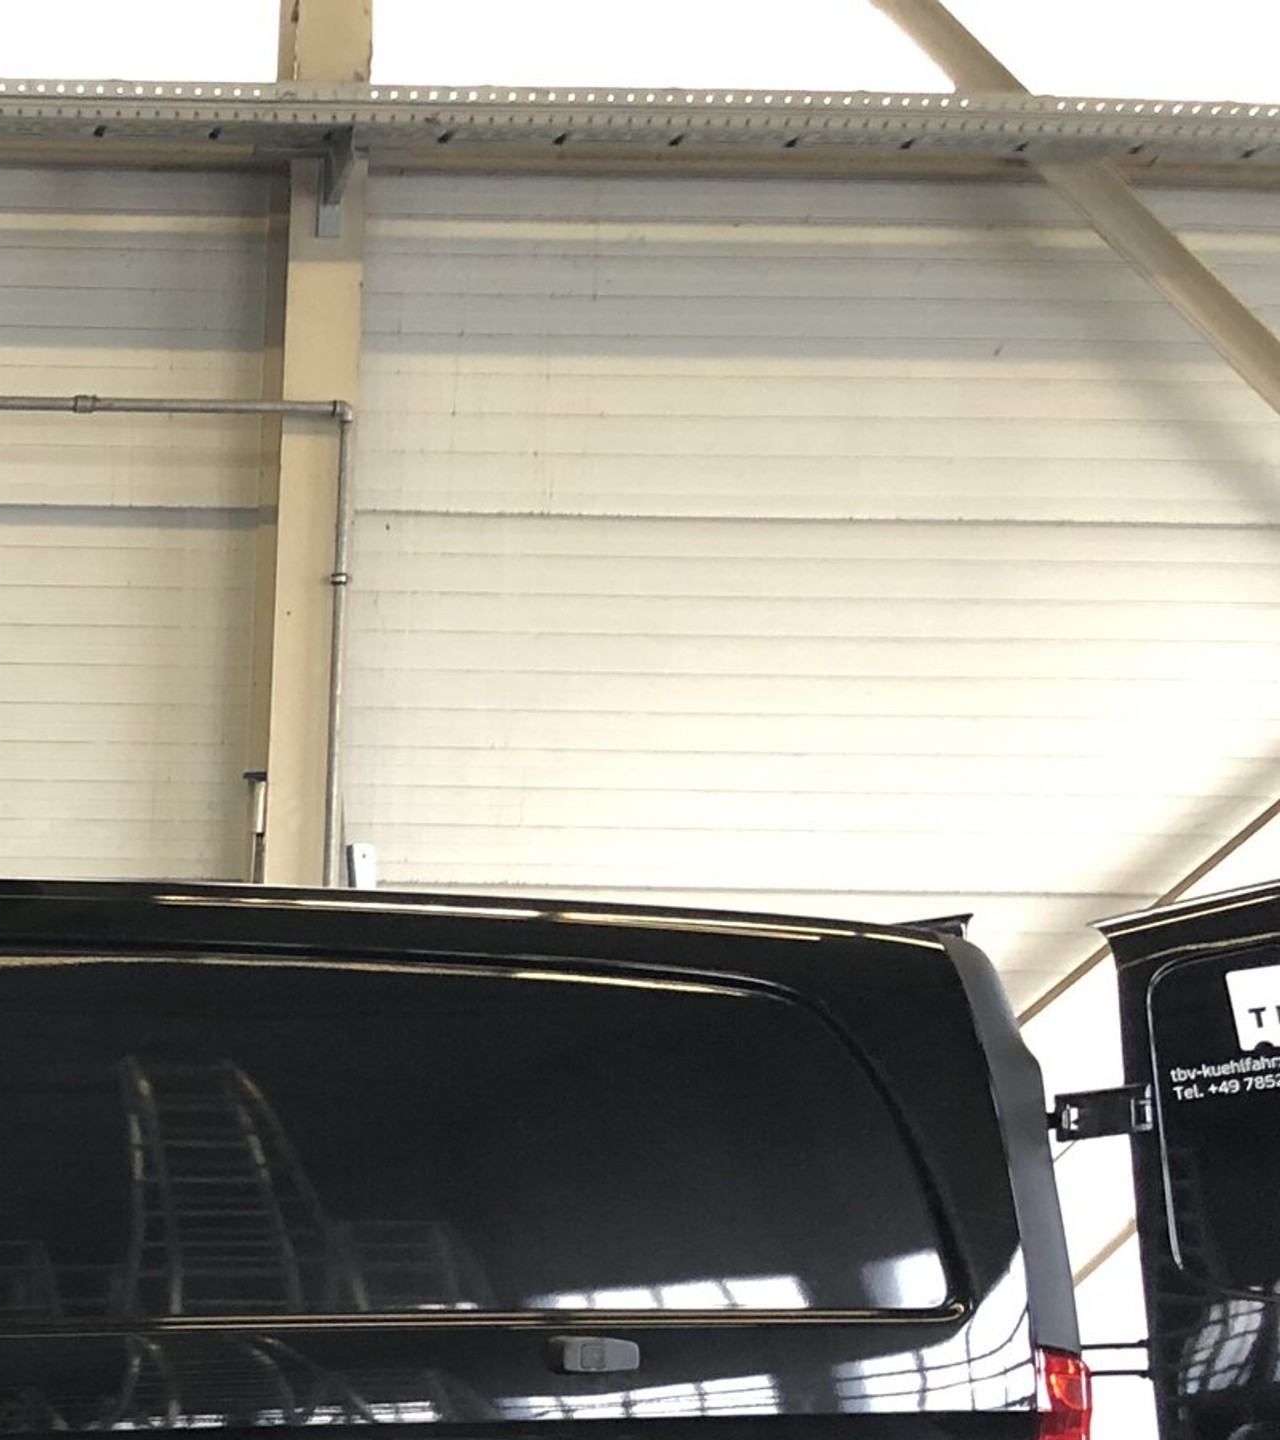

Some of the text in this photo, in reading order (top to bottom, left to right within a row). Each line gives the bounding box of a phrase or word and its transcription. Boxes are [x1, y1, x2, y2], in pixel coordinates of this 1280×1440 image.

[1170, 1056, 1280, 1083] tbv-kuehlfahr
[1173, 1084, 1204, 1101] Tel.
[1208, 1079, 1240, 1094] +49
